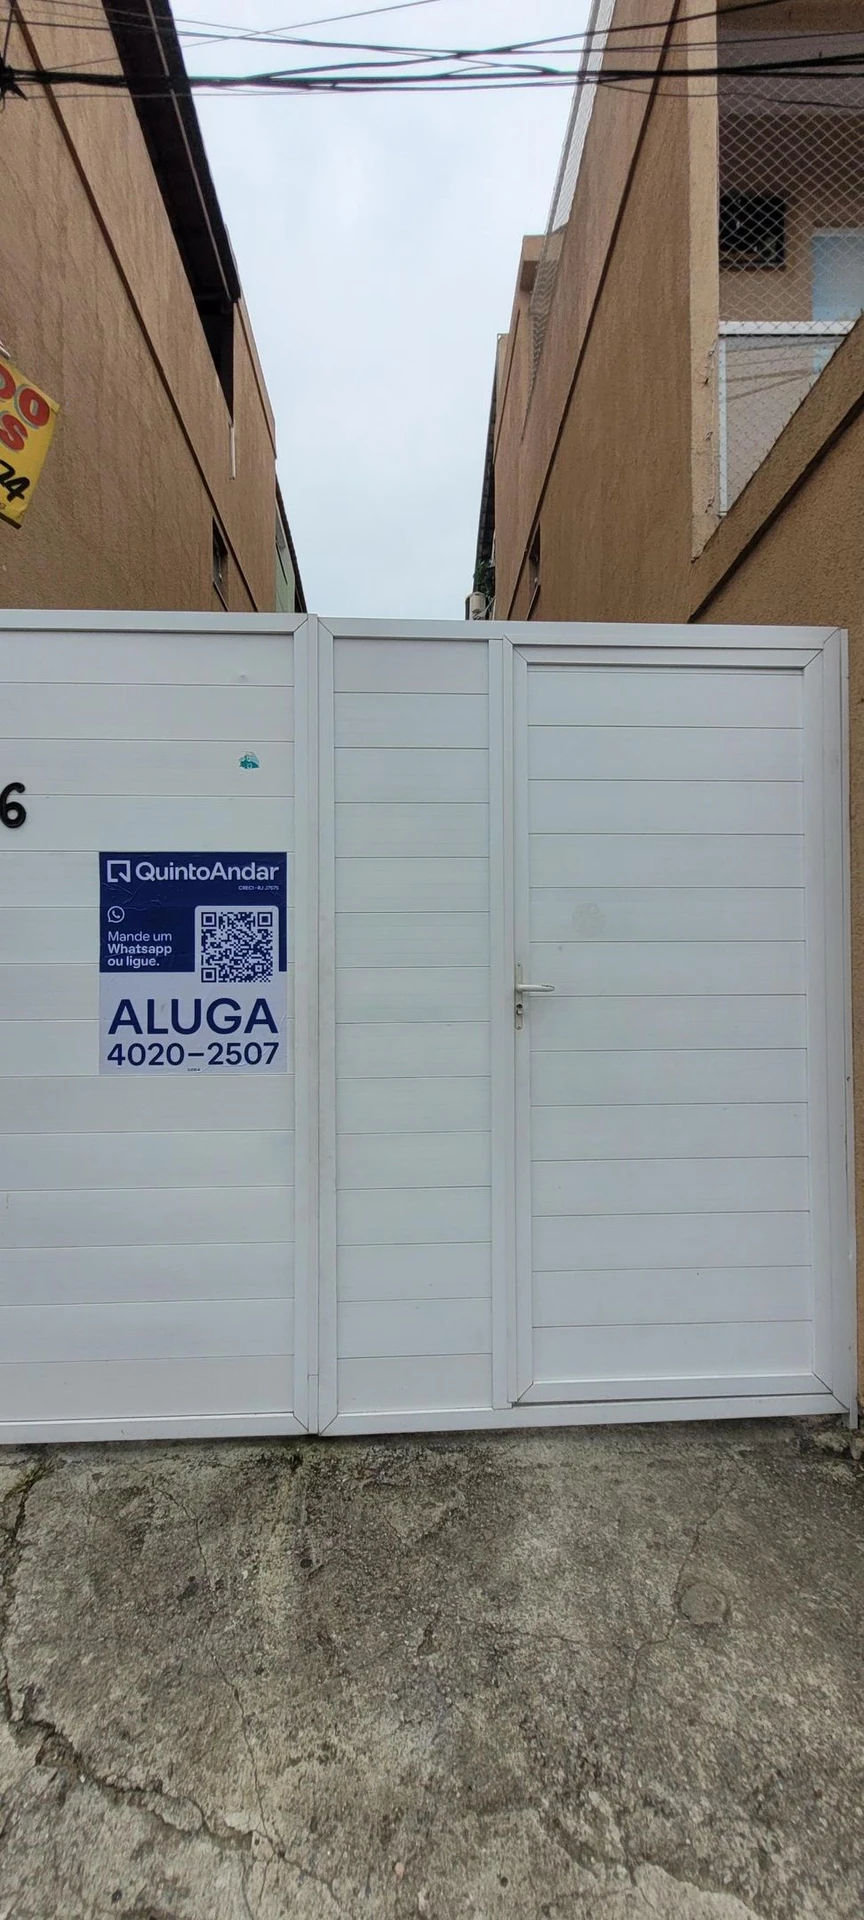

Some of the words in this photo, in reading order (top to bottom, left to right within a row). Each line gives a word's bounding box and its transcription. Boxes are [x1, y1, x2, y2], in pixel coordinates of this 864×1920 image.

[0, 782, 26, 829] 6
[135, 862, 280, 882] QuintoAndar
[107, 931, 150, 942] Mande
[153, 933, 172, 942] um
[107, 944, 172, 956] Whatsapp
[107, 958, 124, 967] ou
[126, 956, 160, 969] ligue.
[108, 998, 279, 1035] ALUGA
[107, 1042, 280, 1066] 4020-2507
